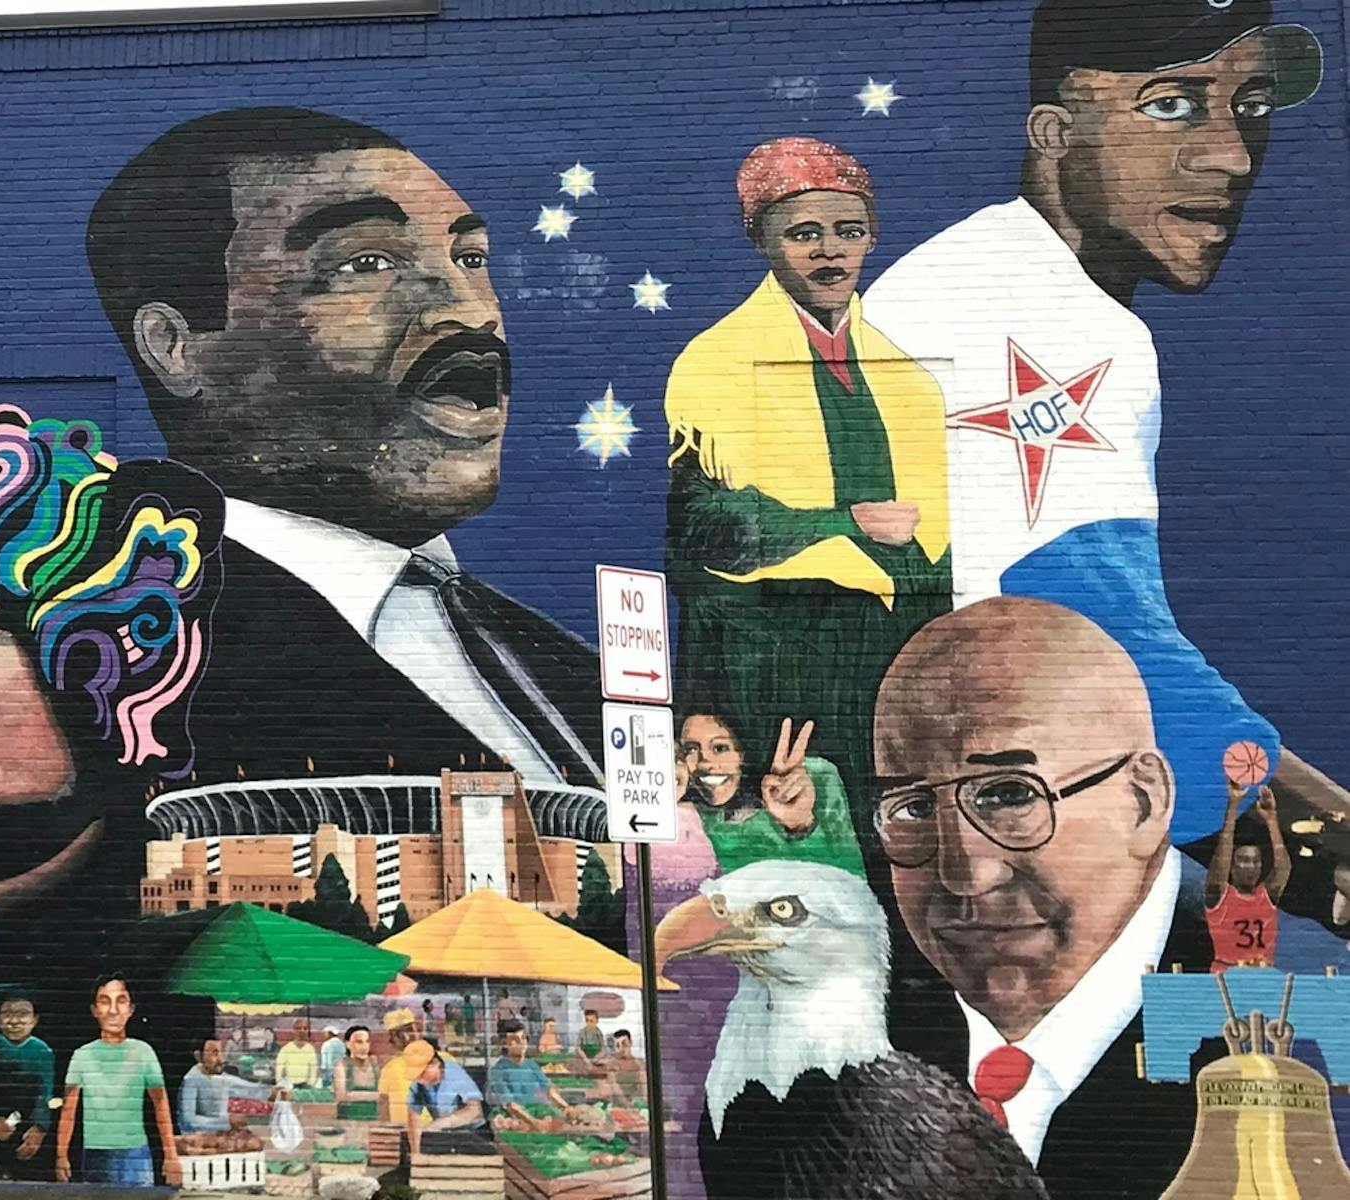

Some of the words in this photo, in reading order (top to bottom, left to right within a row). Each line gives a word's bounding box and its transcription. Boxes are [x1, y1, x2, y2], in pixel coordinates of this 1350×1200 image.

[1011, 392, 1068, 442] HOF
[620, 588, 644, 613] NO
[606, 623, 663, 652] STOPPING
[617, 769, 642, 785] PAY
[646, 771, 665, 786] TO
[623, 789, 660, 805] PARK
[1234, 919, 1266, 949] 31
